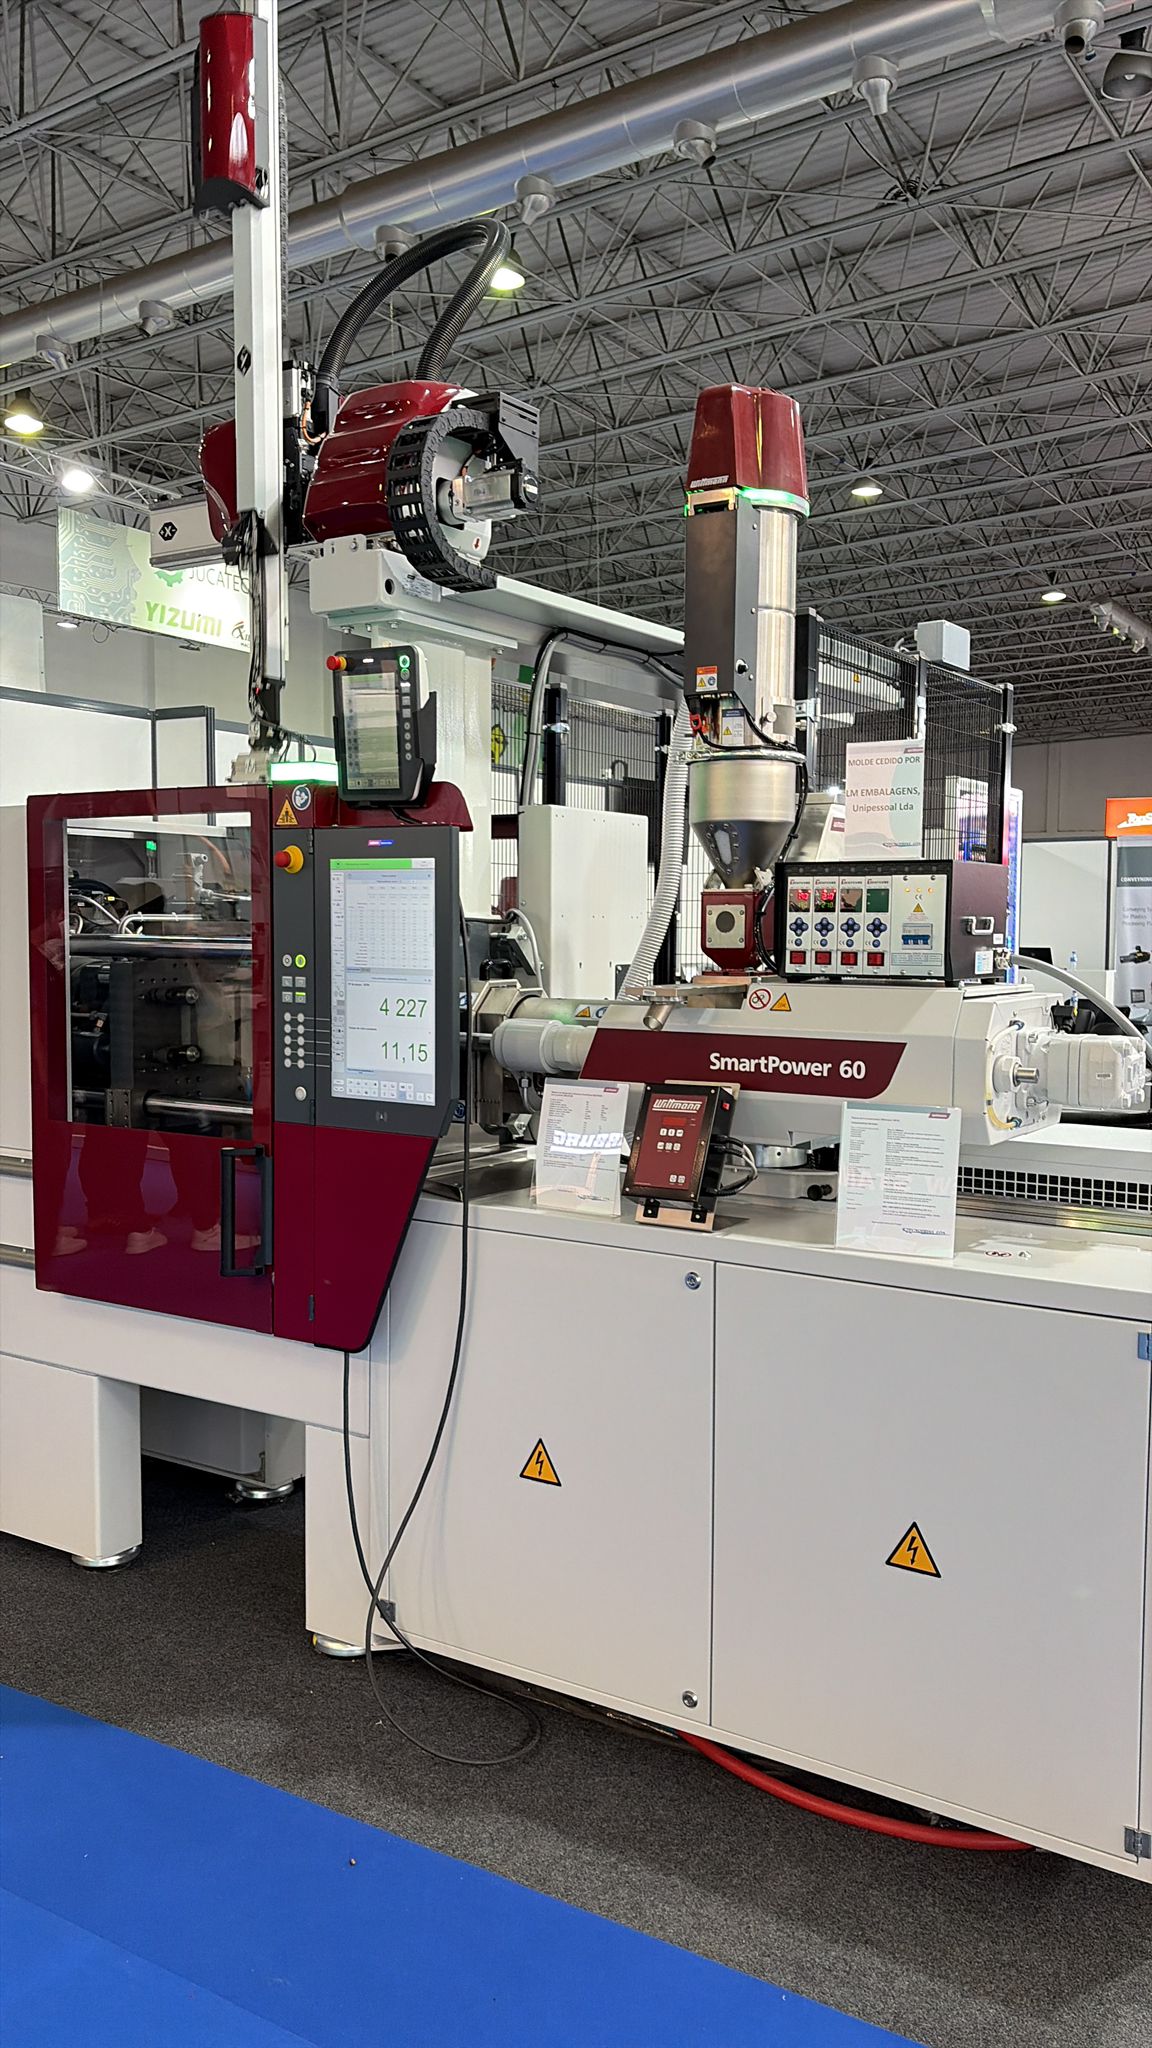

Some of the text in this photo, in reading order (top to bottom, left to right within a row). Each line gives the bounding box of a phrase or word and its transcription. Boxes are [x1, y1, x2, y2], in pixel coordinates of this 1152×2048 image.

[848, 755, 921, 767] MOLDE CEDIDO POR
[846, 786, 921, 798] LM EMBALAGENS,
[852, 802, 914, 814] Unipessoal Lda
[379, 997, 428, 1018] 4 227
[381, 1041, 428, 1062] 11,15
[709, 1052, 866, 1079] SmartPower 60
[652, 1098, 702, 1113] Wittmann
